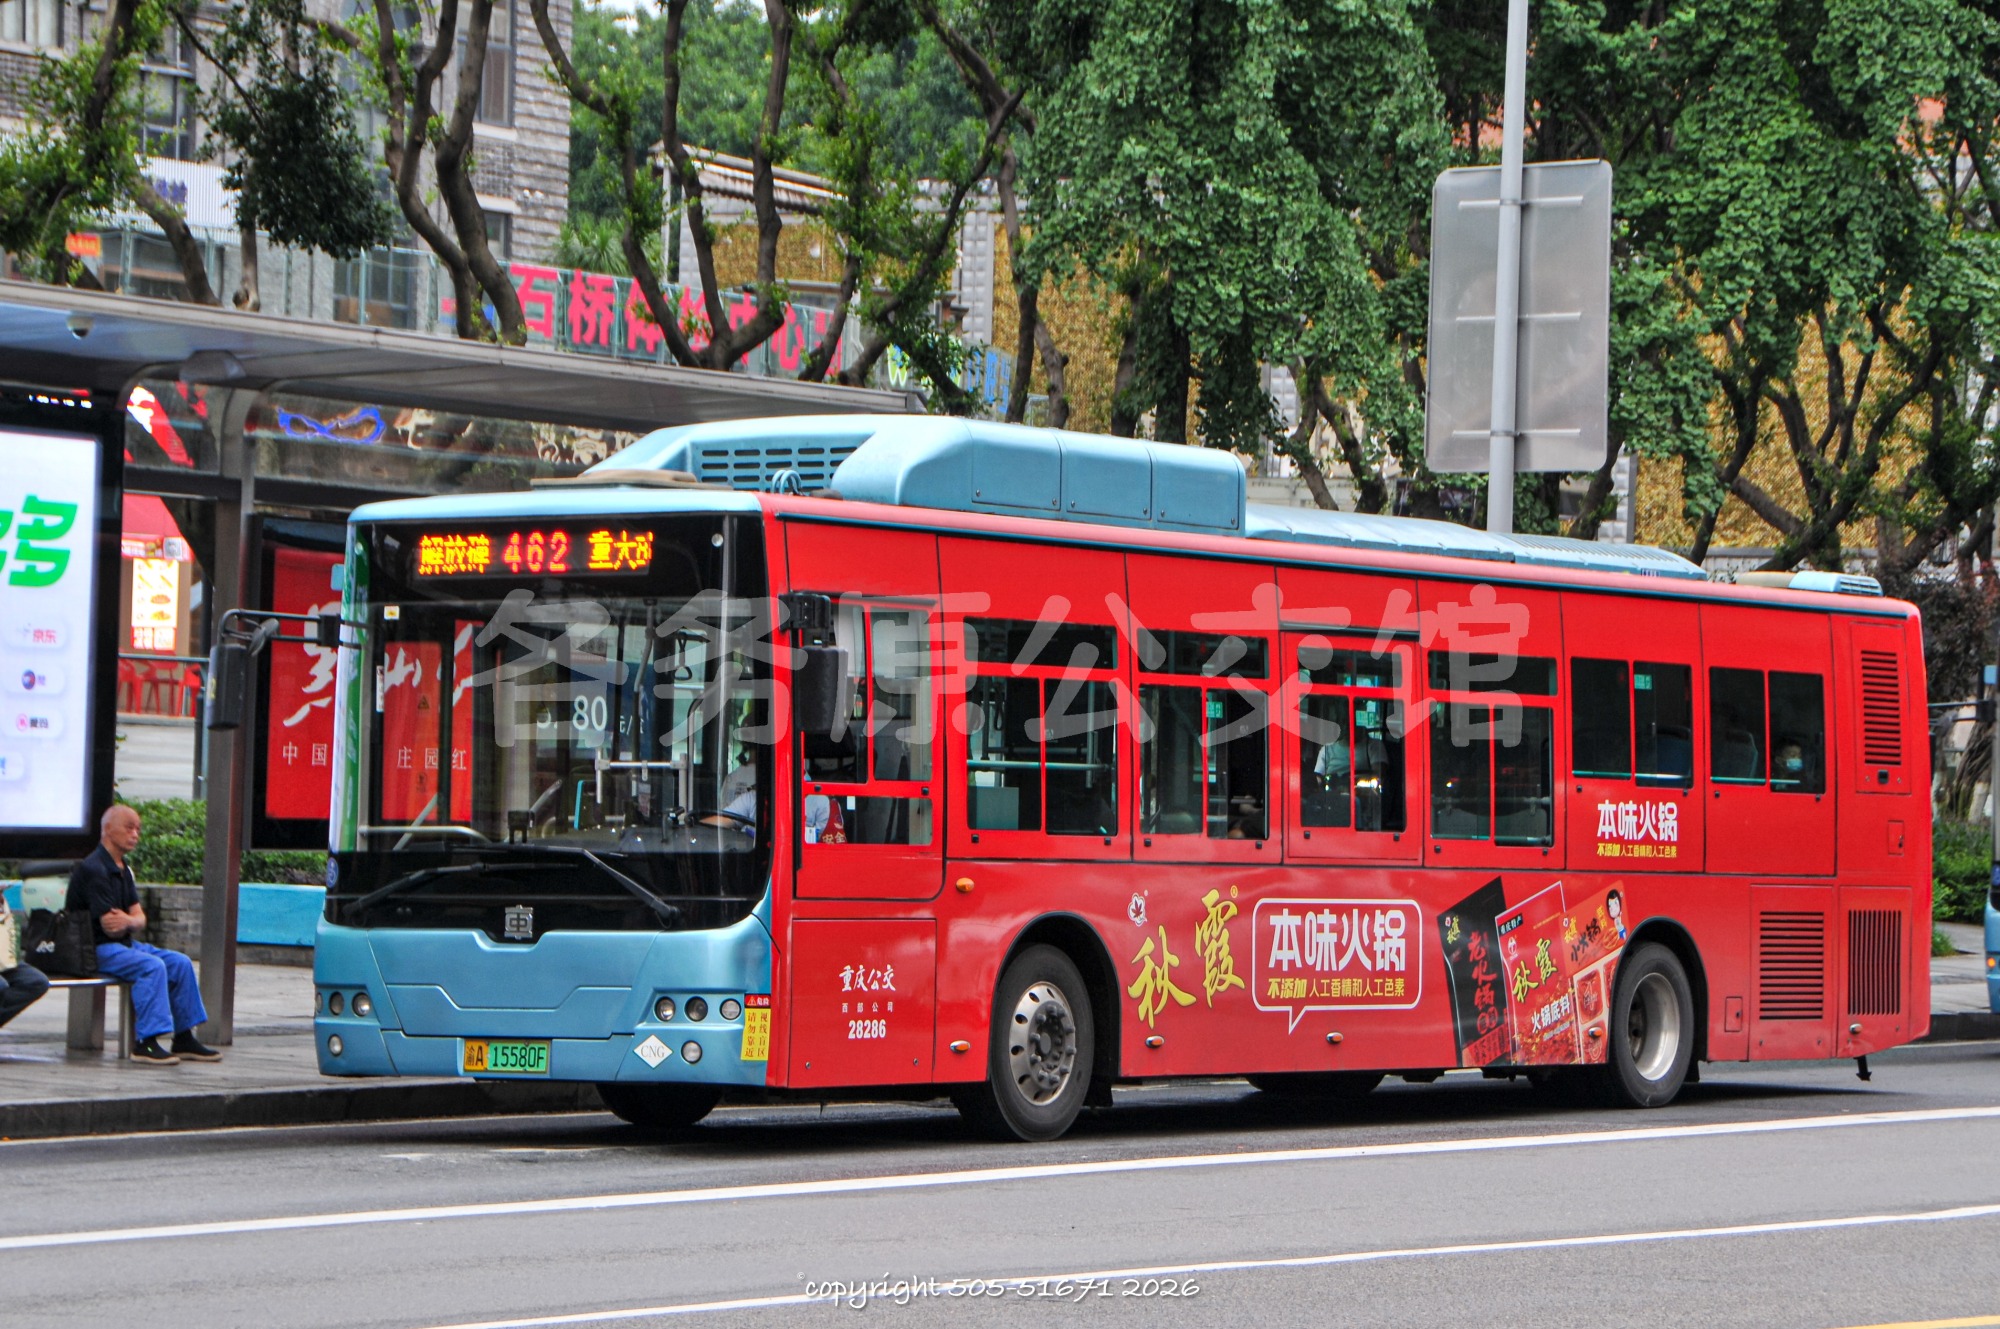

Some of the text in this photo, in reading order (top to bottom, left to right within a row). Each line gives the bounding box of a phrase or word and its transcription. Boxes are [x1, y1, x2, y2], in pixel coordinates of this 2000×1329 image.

[503, 531, 569, 573] 462
[1596, 800, 1678, 841] 本味火锅
[1268, 908, 1406, 972] 本味火锅
[838, 964, 897, 992] 重庆公交
[1267, 977, 1405, 999] 不添加人工香精和人工色素
[847, 1019, 887, 1039] 28286
[1531, 993, 1571, 1034] 火锅底料
[640, 1045, 666, 1058] CNG
